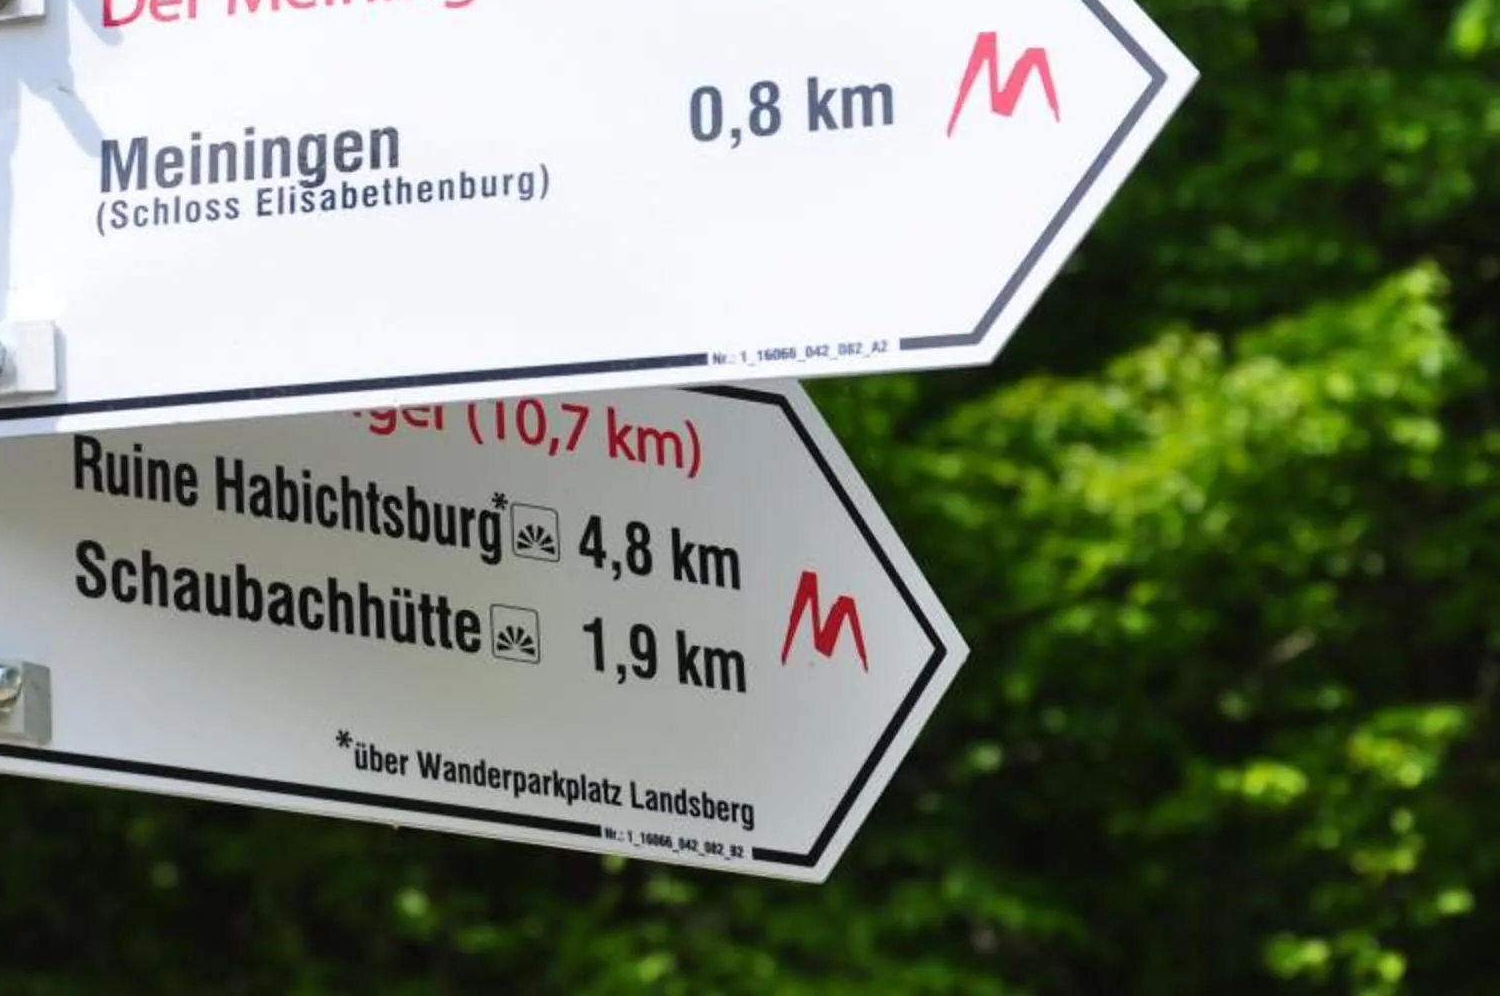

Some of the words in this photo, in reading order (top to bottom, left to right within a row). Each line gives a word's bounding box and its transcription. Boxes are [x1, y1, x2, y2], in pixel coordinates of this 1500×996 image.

[690, 80, 782, 149] 0,8
[807, 76, 894, 132] km
[100, 125, 400, 193] Meiningen
[96, 195, 240, 237] (Schloss
[256, 163, 550, 218] Elisabethenburg)
[73, 434, 199, 507] Ruine
[467, 399, 589, 457] (10,7
[608, 406, 702, 479] km)
[579, 515, 653, 581] 4,8
[671, 527, 741, 591] km
[75, 539, 482, 654] Schaubachhütte
[583, 617, 657, 685] 1,9
[676, 630, 746, 702] km
[417, 750, 622, 806] Wanderparkplatz
[629, 780, 756, 831] Landsberg
